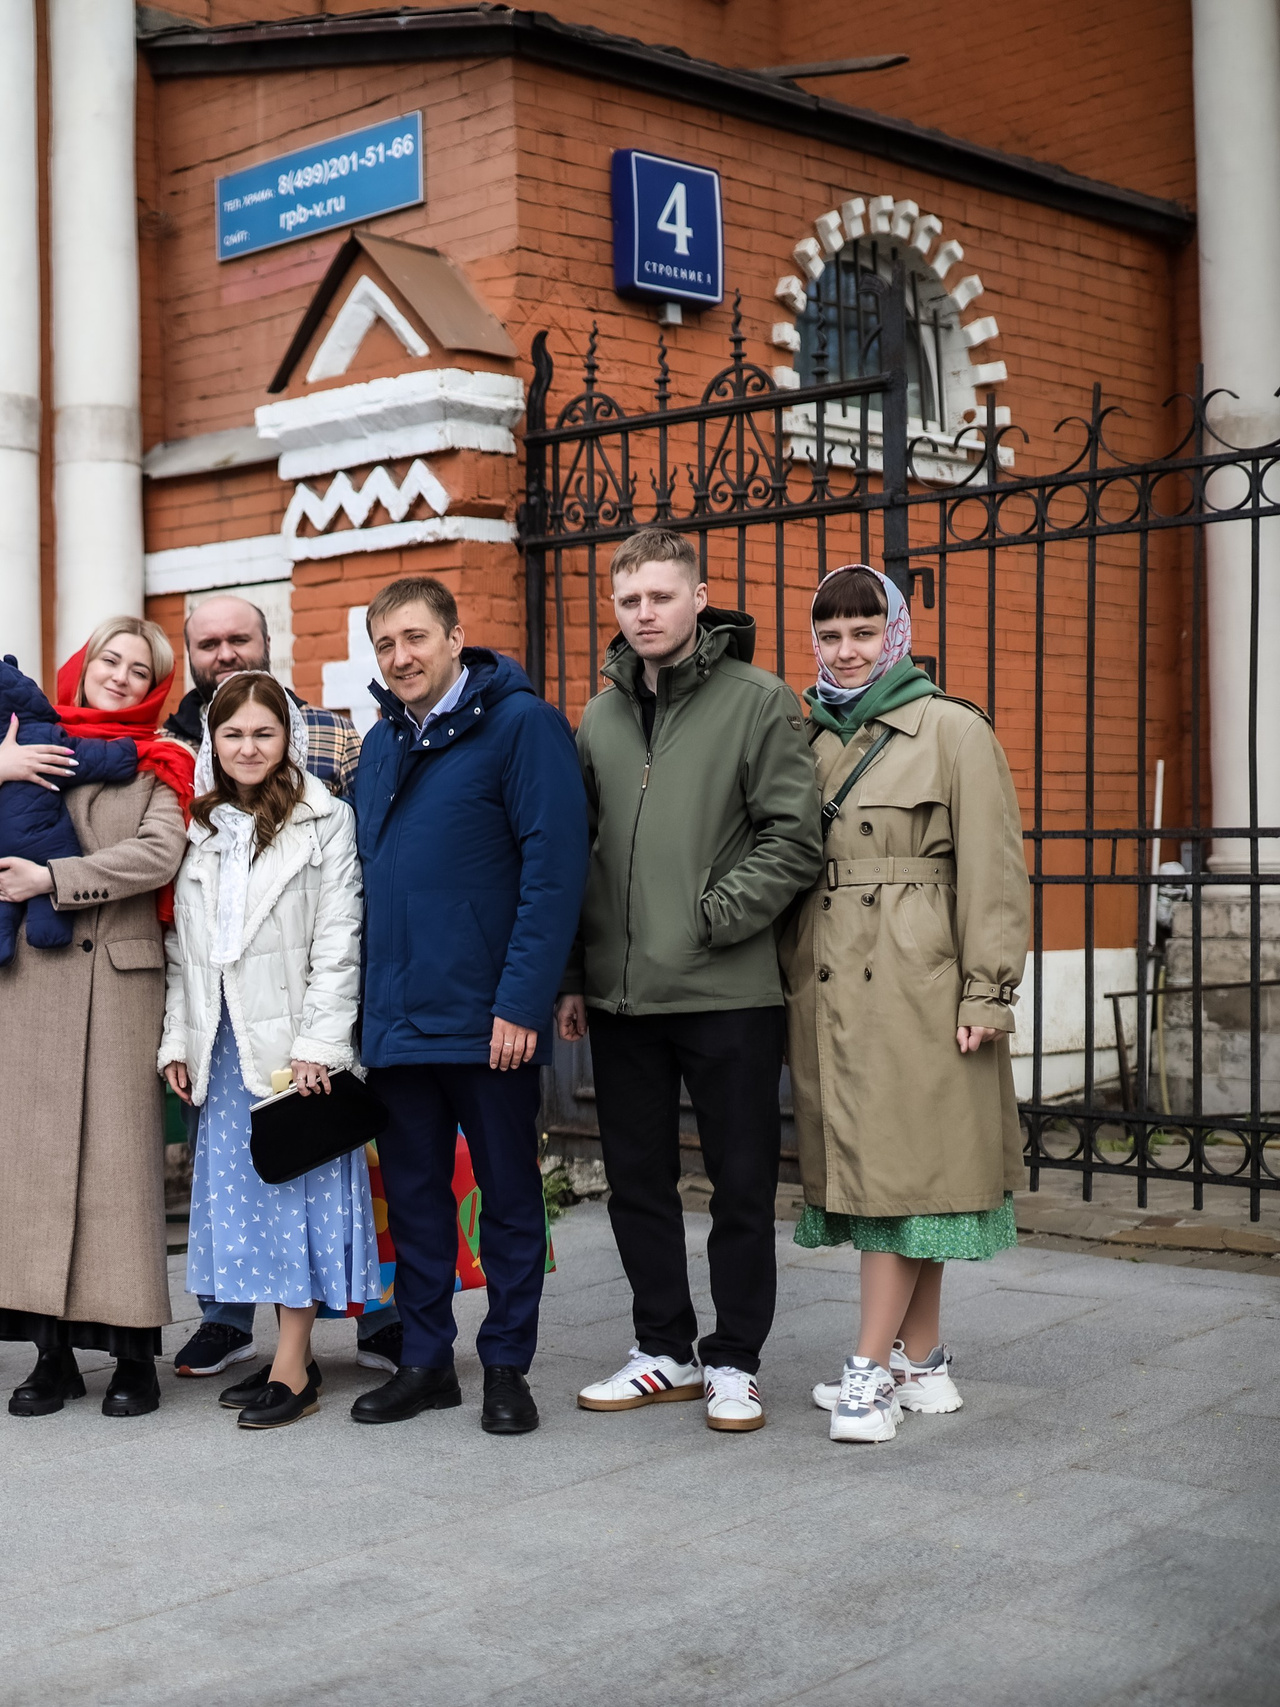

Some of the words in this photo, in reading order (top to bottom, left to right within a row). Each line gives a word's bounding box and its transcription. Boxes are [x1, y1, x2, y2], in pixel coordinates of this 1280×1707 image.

[278, 133, 414, 196] 8(499)201-51-66
[279, 195, 346, 232] rpb-v.ru
[657, 181, 694, 256] 4
[644, 260, 704, 284] СТРОЕНИЕ
[706, 272, 712, 285] 1
